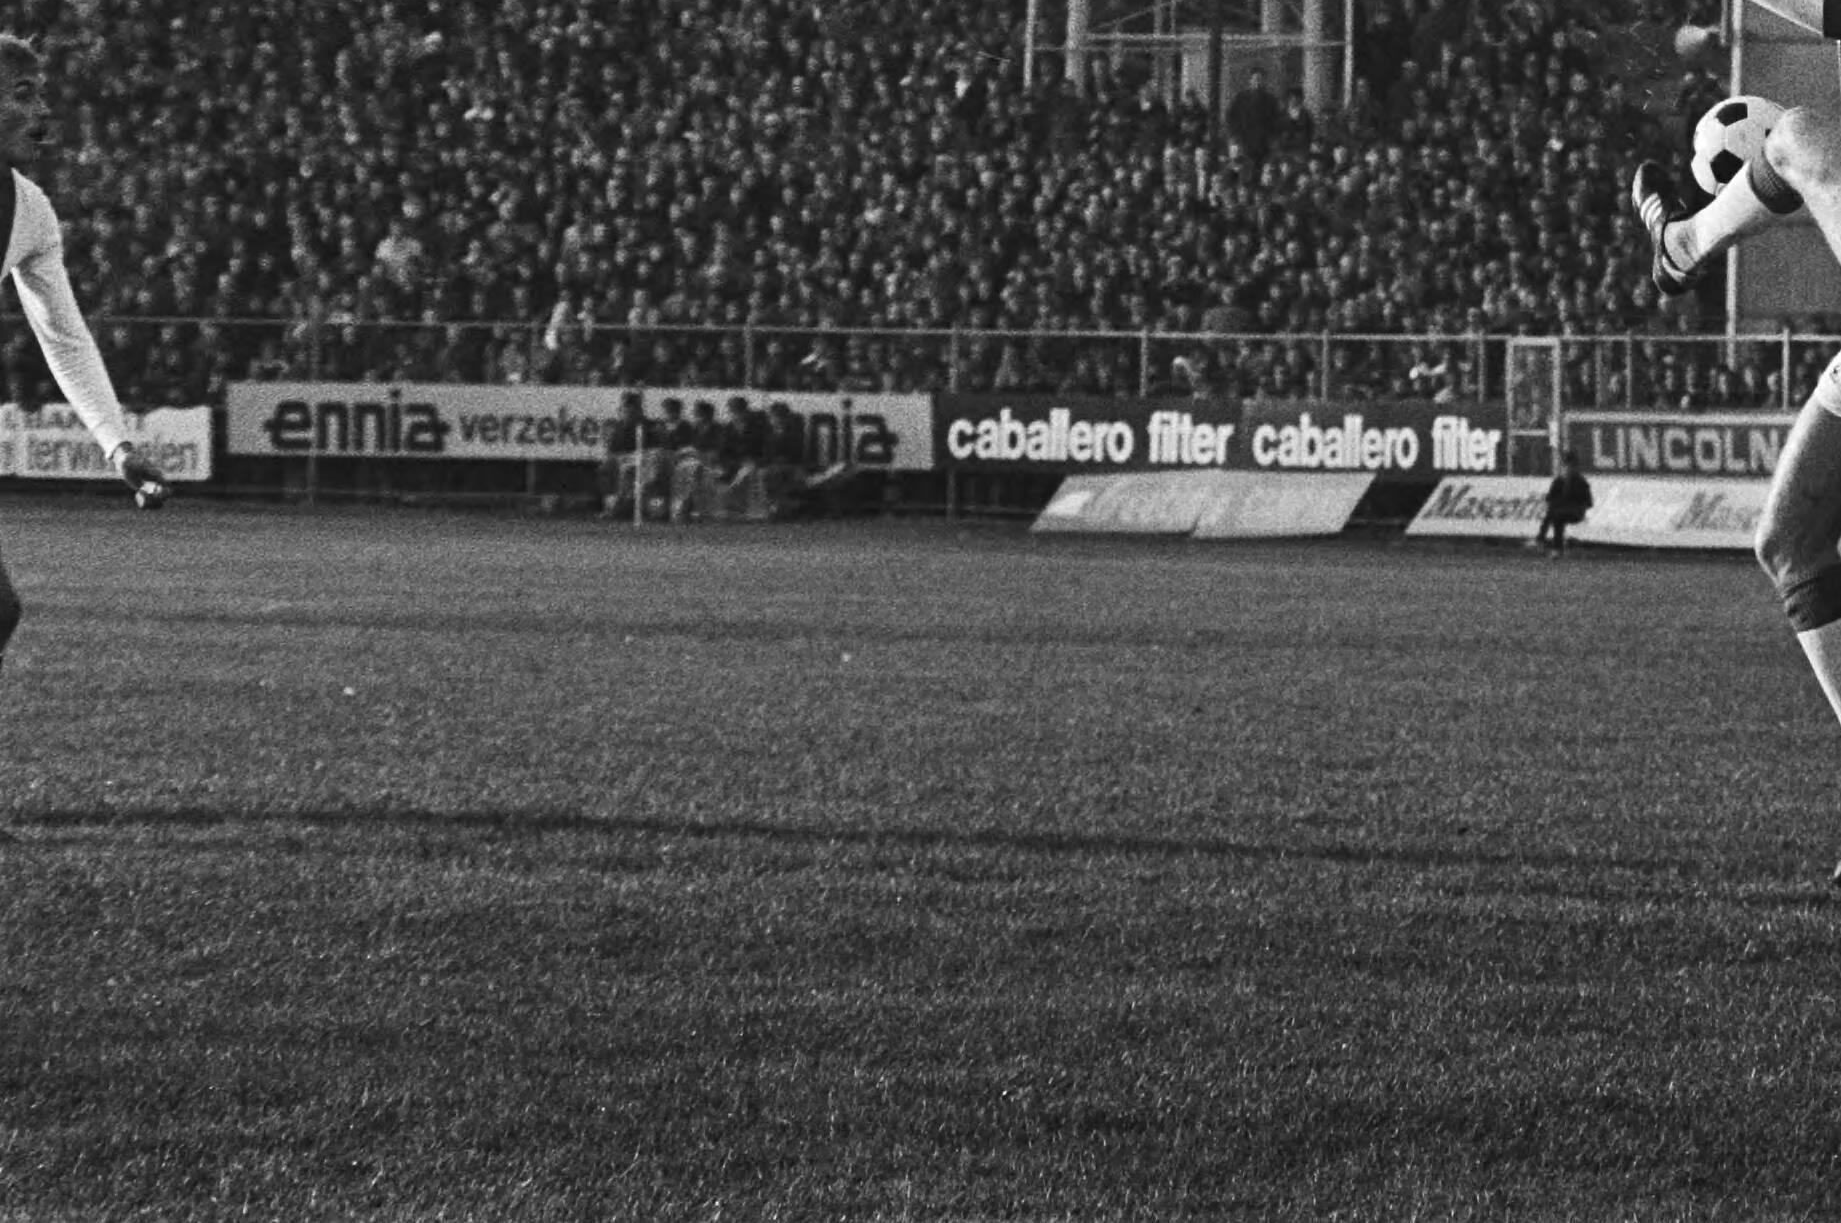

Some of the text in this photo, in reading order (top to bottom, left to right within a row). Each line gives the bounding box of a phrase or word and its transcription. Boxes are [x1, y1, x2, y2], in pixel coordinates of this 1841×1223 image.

[265, 389, 602, 451] ennia verzeke
[947, 407, 1235, 465] caballero filter
[1252, 413, 1502, 471] caballero filter
[1592, 428, 1781, 471] LINCOLN
